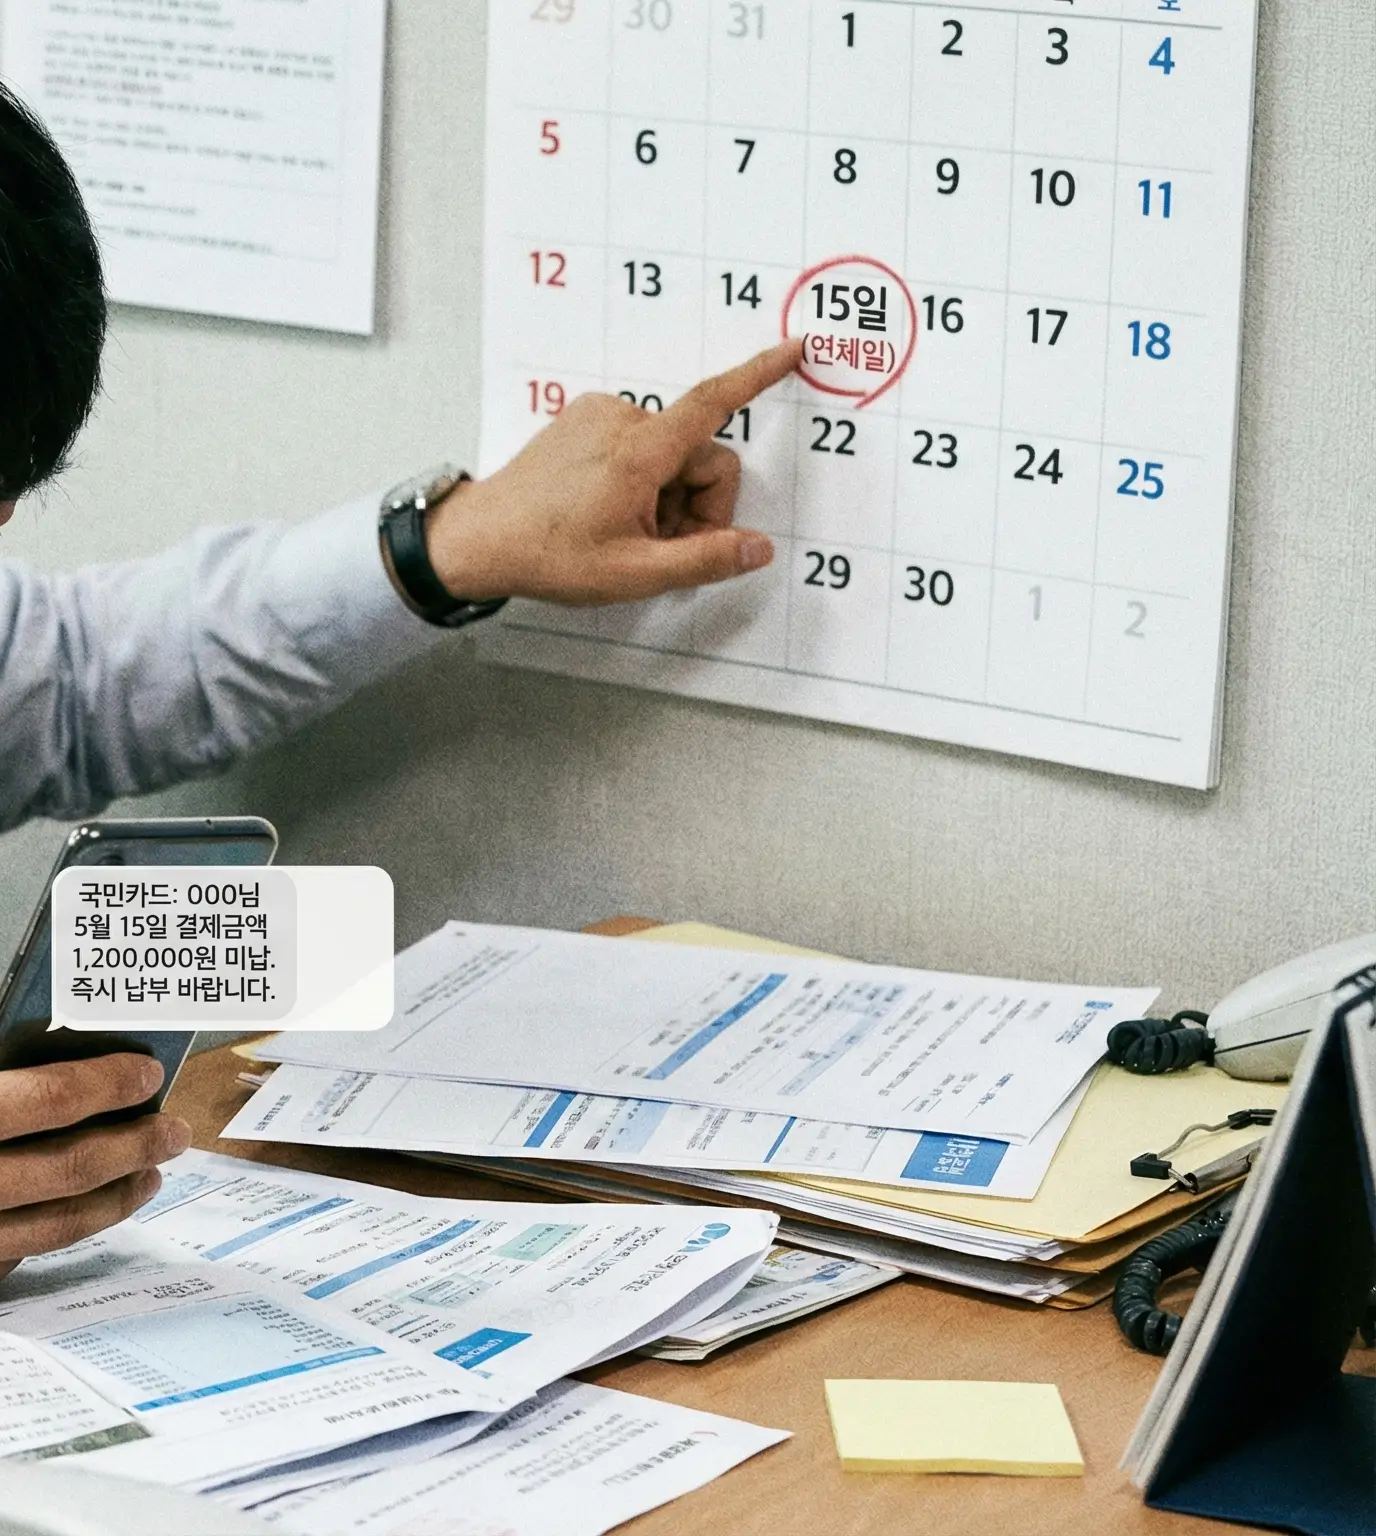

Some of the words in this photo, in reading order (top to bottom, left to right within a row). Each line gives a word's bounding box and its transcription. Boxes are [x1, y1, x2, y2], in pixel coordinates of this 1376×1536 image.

[625, 0, 672, 31] 30
[727, 3, 764, 39] 31
[841, 12, 854, 47] 1
[941, 20, 963, 56] 2
[1046, 27, 1068, 65] 3
[1148, 37, 1175, 75] 4
[541, 121, 560, 155] 5
[635, 130, 657, 165] 6
[734, 139, 755, 173] 7
[834, 148, 856, 184] 8
[936, 158, 959, 195] 9
[1031, 168, 1075, 206] 10
[1138, 180, 1172, 218] 11
[531, 252, 566, 287] 12
[624, 261, 661, 297] 13
[721, 272, 762, 309] 14
[811, 283, 887, 332] 15일
[922, 295, 964, 333] 16
[1027, 308, 1068, 345] 17
[1127, 321, 1171, 360] 18
[802, 333, 895, 374] (연체일)
[528, 380, 565, 415] 19
[811, 417, 856, 455] 22
[912, 430, 958, 468] 23
[1014, 444, 1064, 484] 24
[1117, 459, 1164, 499] 25
[805, 551, 851, 589] 29
[904, 566, 954, 606] 30
[1030, 587, 1042, 620] 1
[1125, 602, 1146, 638] 2
